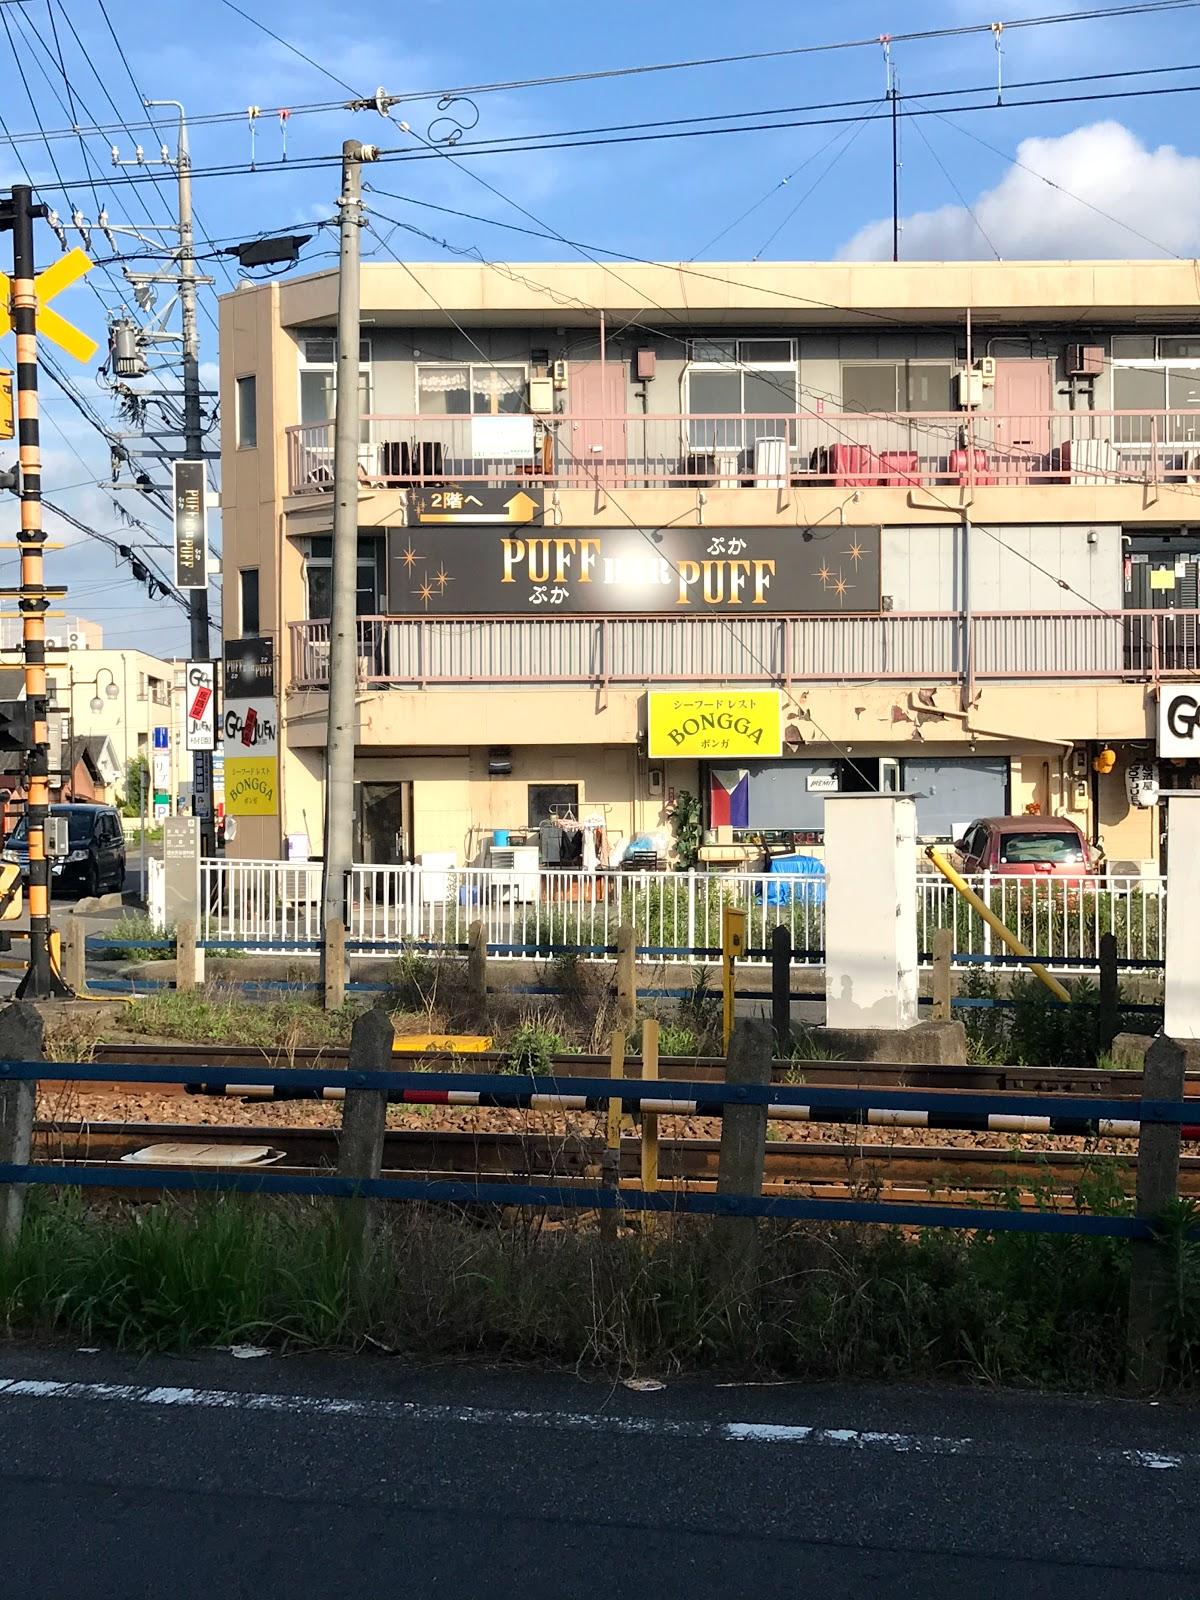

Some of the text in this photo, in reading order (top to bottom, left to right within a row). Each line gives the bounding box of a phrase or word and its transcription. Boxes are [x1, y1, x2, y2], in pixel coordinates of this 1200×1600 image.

[185, 489, 200, 519] PUFF
[430, 492, 483, 509] 2階へ
[180, 539, 194, 569] PUFF
[706, 537, 747, 556] ぷか
[500, 538, 601, 583] PUFF
[676, 559, 776, 604] PUFF
[528, 586, 570, 605] ぷか
[673, 699, 757, 710] シーフード レスト
[1167, 694, 1200, 740] G
[667, 712, 764, 747] BONGGA
[230, 777, 273, 802] BONGGA
